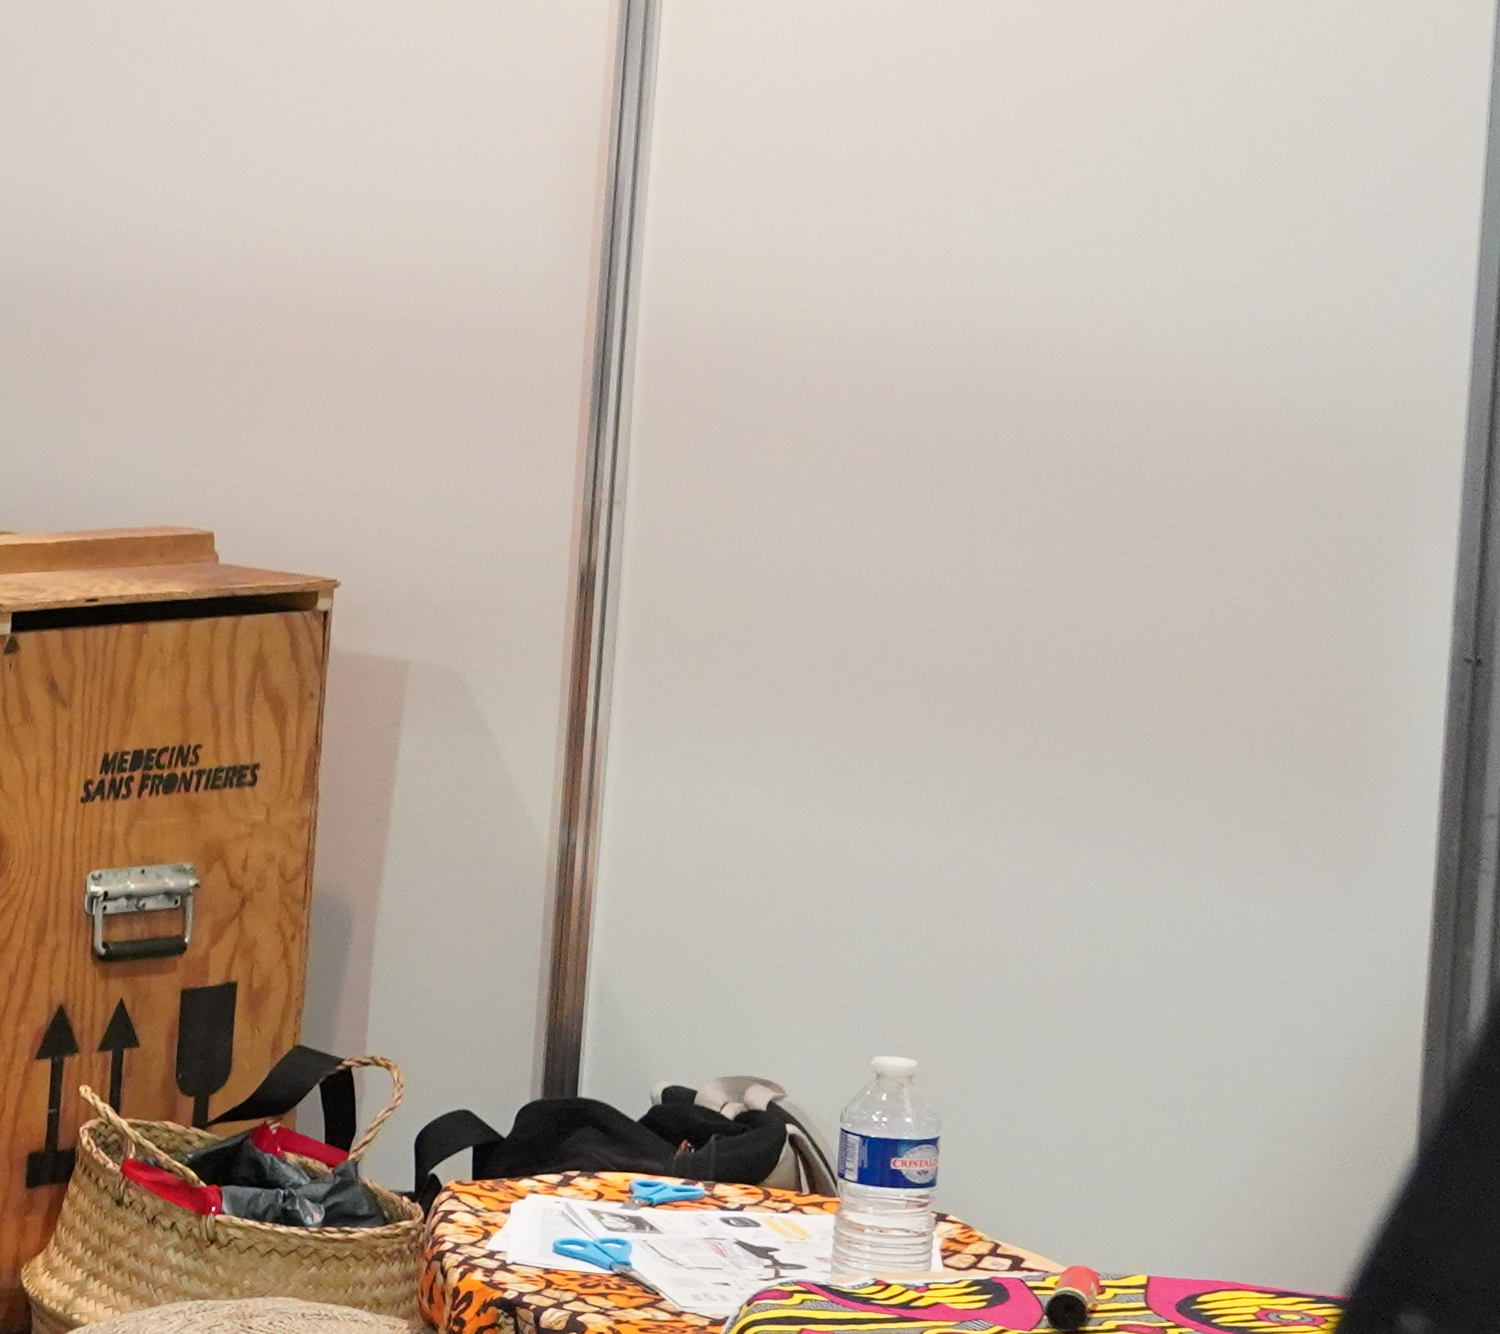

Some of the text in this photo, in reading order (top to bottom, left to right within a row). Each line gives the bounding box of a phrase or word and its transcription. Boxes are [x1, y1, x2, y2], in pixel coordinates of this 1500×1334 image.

[99, 744, 203, 775] MEDECINS
[81, 762, 261, 803] SANS FRONTIERES
